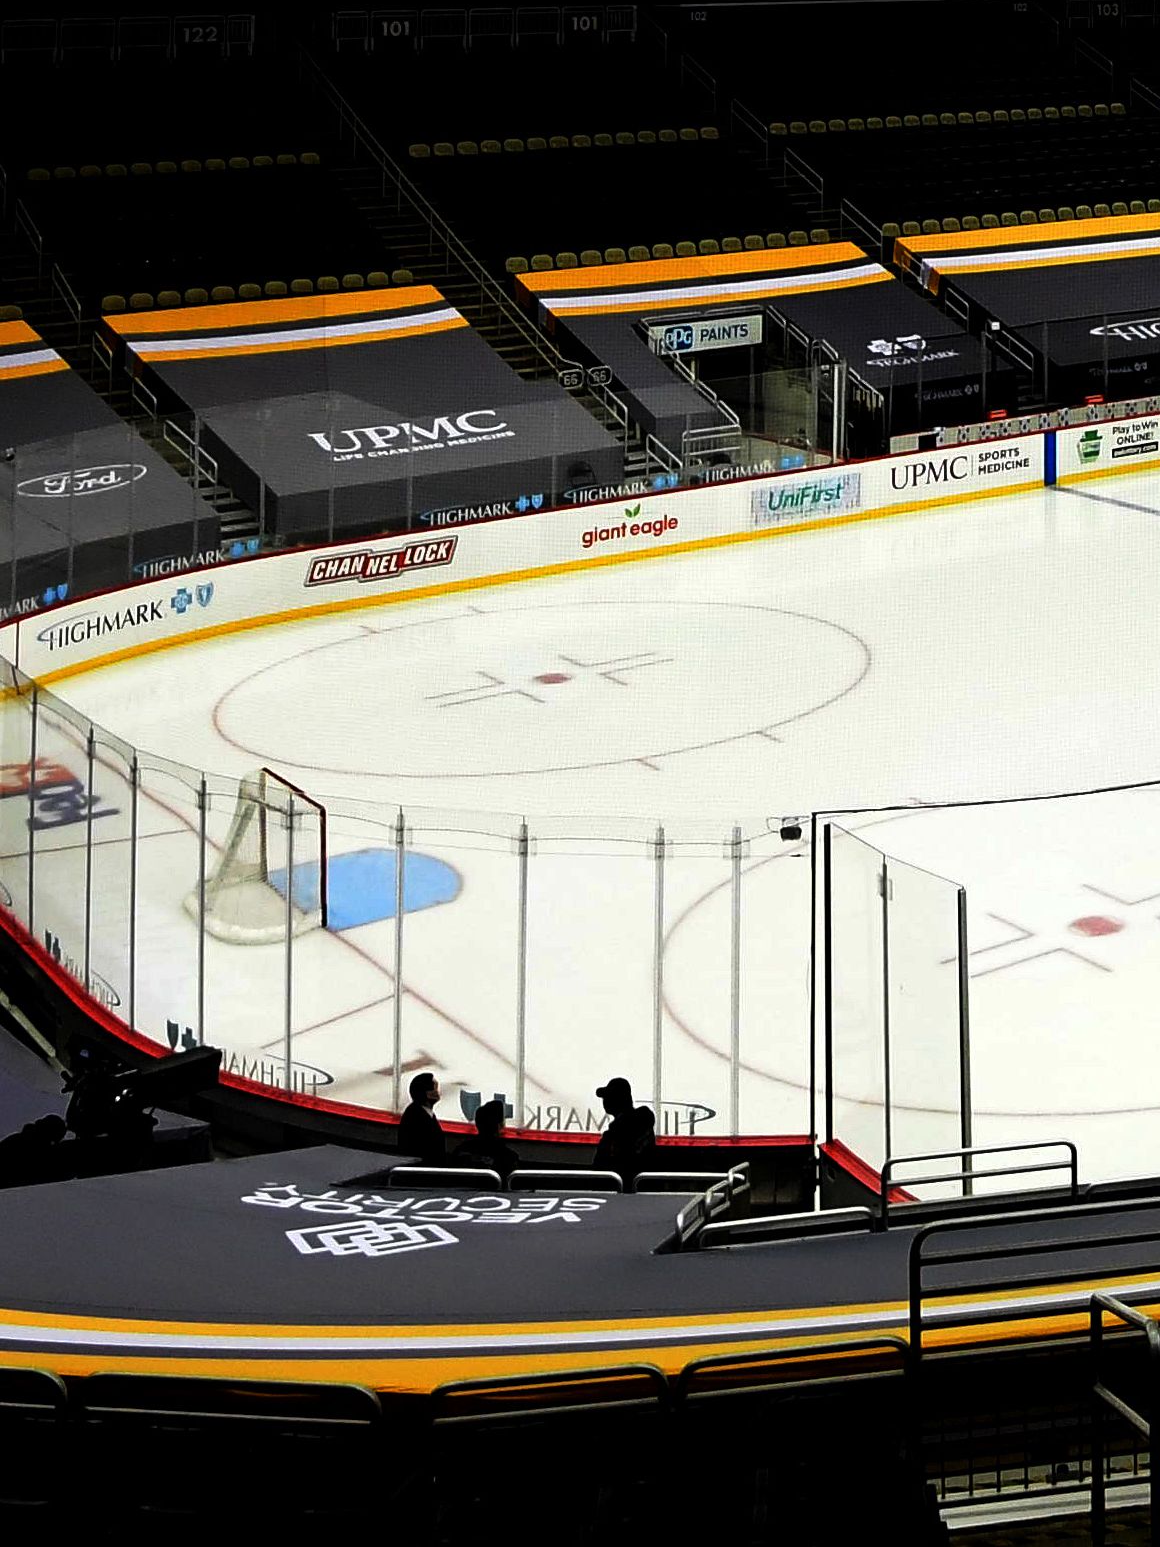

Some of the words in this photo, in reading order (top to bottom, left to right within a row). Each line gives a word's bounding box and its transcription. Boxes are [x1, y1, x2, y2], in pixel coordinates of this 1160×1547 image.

[183, 26, 219, 45] 122
[381, 20, 411, 37] 101
[571, 16, 599, 32] 101
[665, 325, 693, 350] PPG
[700, 324, 749, 342] PAINTS
[308, 409, 508, 453] UPMC
[447, 430, 516, 446] MEDICINE
[1112, 424, 1130, 436] Play
[1131, 422, 1141, 432] to
[1141, 420, 1159, 431] Win
[1116, 431, 1155, 446] ONLINE!
[978, 447, 1021, 463] SPORTS
[978, 457, 1030, 476] MEDICINE
[44, 469, 122, 494] Ford
[704, 461, 776, 483] HIGHMARK
[891, 455, 968, 491] UPMC
[572, 481, 650, 504] HIGHMARK
[768, 482, 845, 512] UniFirst
[429, 501, 513, 527] HIGHMARK
[582, 521, 628, 549] giant
[630, 515, 679, 538] eagle
[141, 548, 225, 579] HIGHMARK
[49, 599, 164, 651] HIGHMARK
[241, 1195, 582, 1223] VECTOR
[257, 1182, 608, 1213] SECURITY
